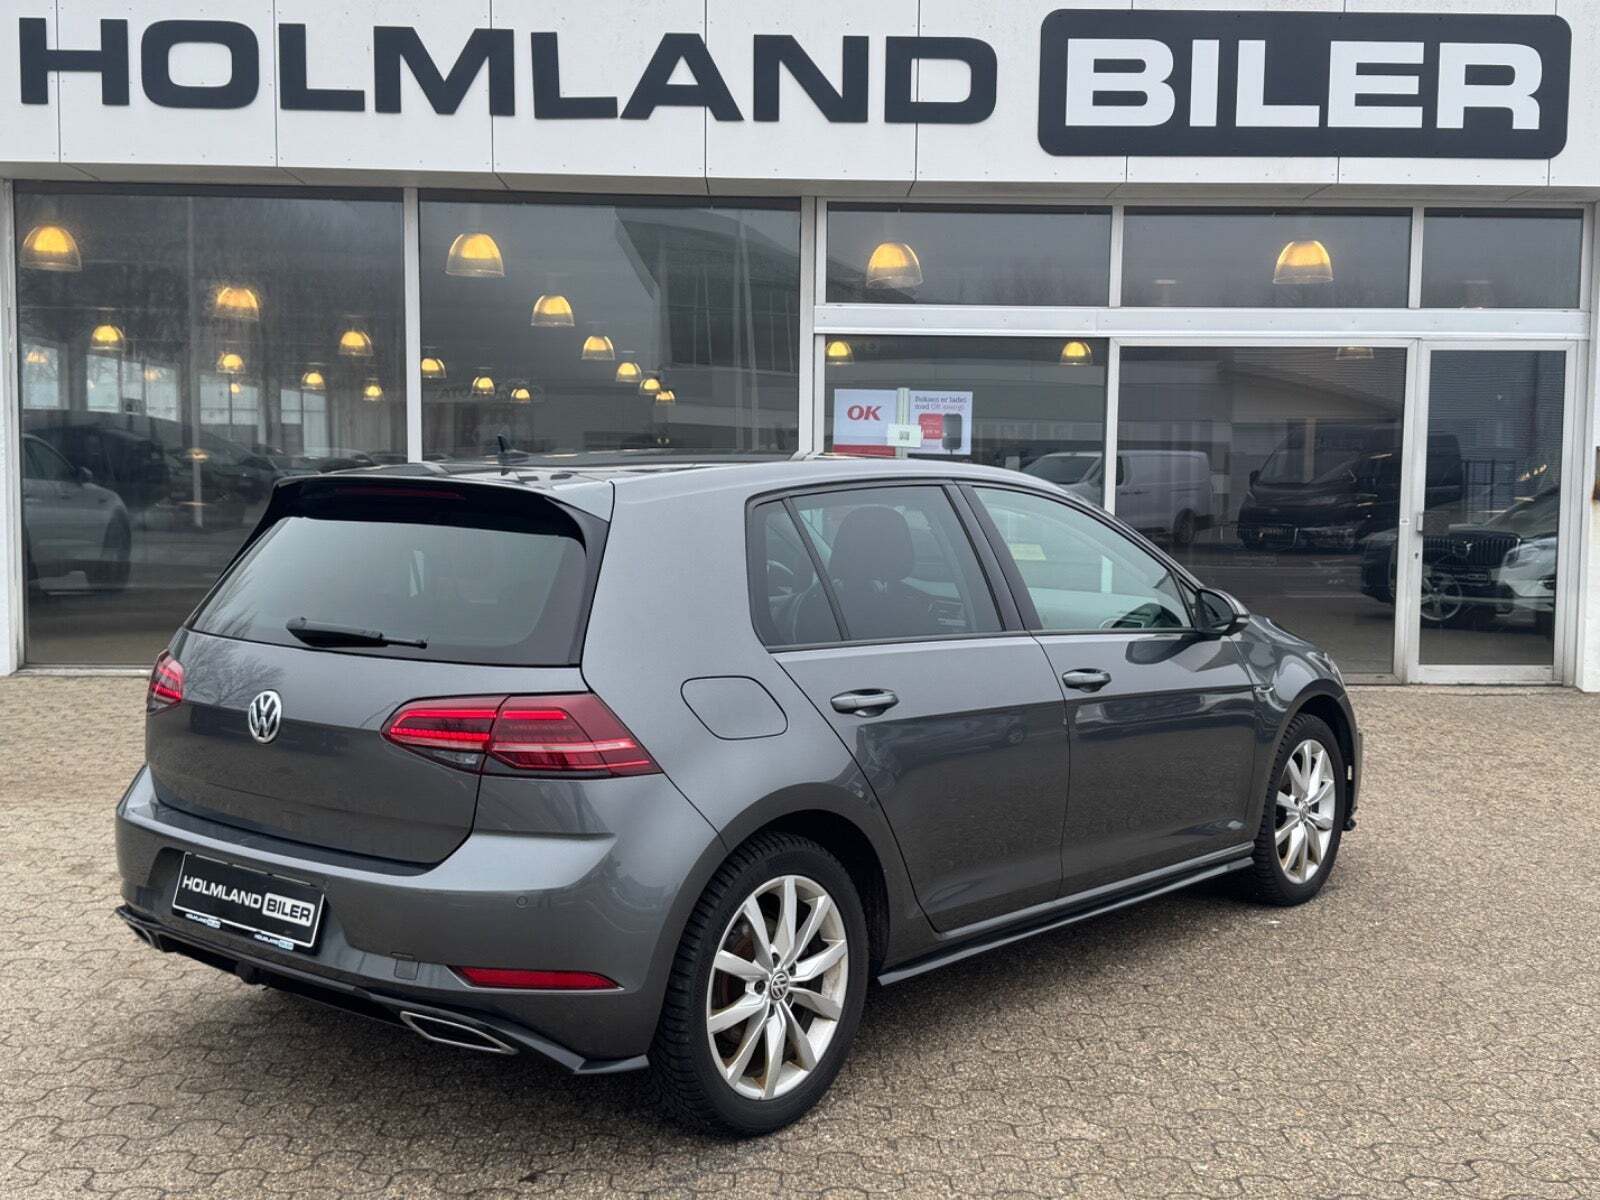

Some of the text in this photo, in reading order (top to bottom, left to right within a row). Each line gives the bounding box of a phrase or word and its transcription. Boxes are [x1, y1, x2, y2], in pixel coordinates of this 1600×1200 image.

[19, 18, 1542, 130] HOLMLAND BILER
[847, 405, 881, 421] OK
[182, 875, 312, 922] HOLMLAND BILER
